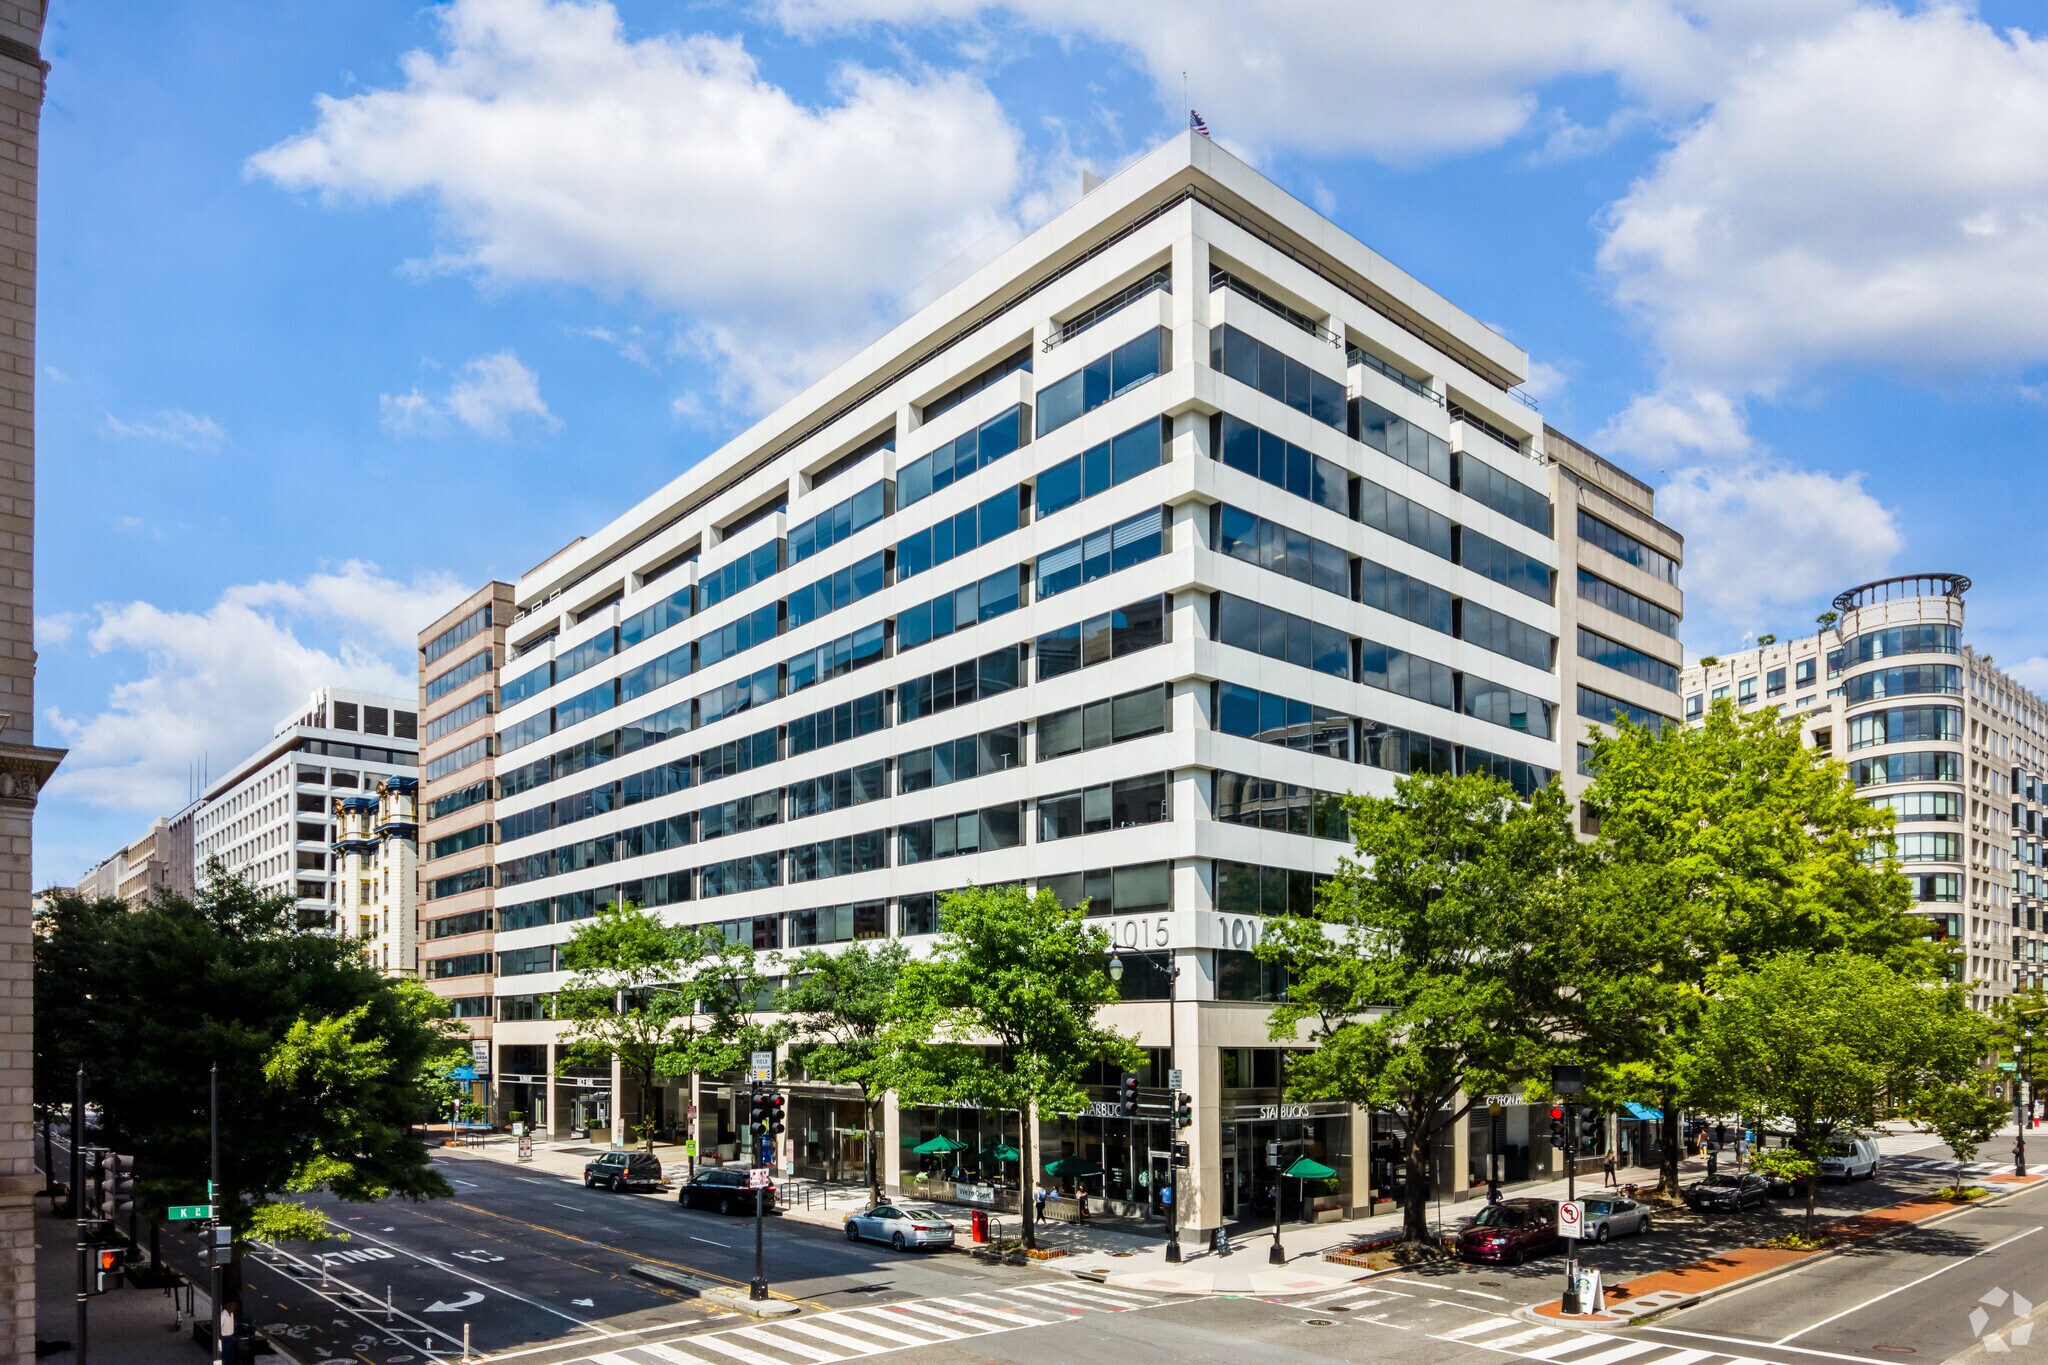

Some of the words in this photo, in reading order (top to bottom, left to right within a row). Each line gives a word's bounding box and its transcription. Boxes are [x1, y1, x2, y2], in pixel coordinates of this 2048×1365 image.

[1111, 917, 1169, 949] 1015
[1079, 1103, 1121, 1117] STARBUC
[1260, 1105, 1309, 1119] STABUCKS
[959, 1187, 974, 1197] We're
[180, 1208, 187, 1218] K
[312, 1247, 396, 1267] ONLY
